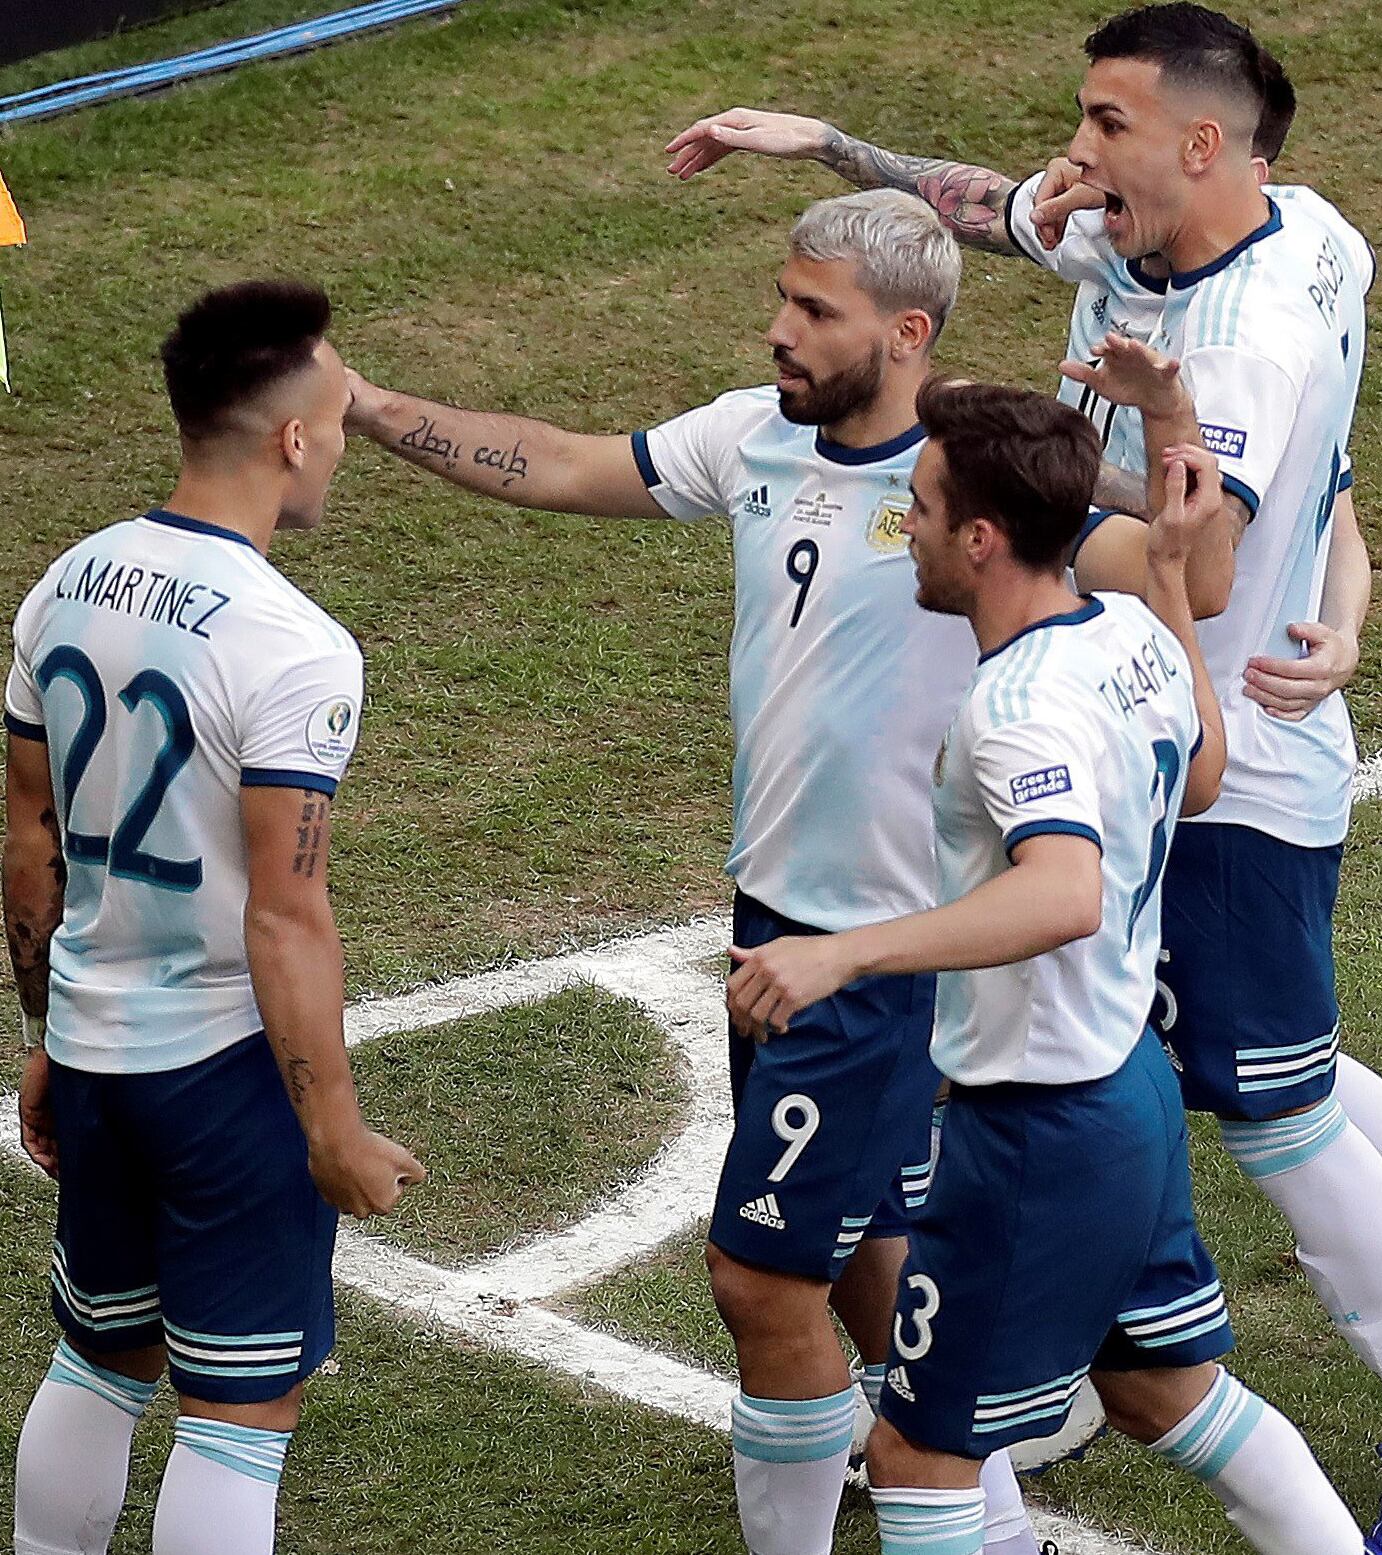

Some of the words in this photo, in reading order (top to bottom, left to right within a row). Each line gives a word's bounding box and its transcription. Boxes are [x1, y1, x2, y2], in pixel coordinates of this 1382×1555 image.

[1200, 426, 1223, 440] ree
[1225, 430, 1244, 444] en
[786, 538, 819, 629] 9
[33, 643, 203, 894] 22
[1012, 773, 1046, 790] Cree
[1047, 768, 1067, 781] en
[1015, 779, 1066, 803] grande
[767, 1093, 820, 1182] 9
[739, 1206, 786, 1230] adidas
[893, 1272, 941, 1361] 3
